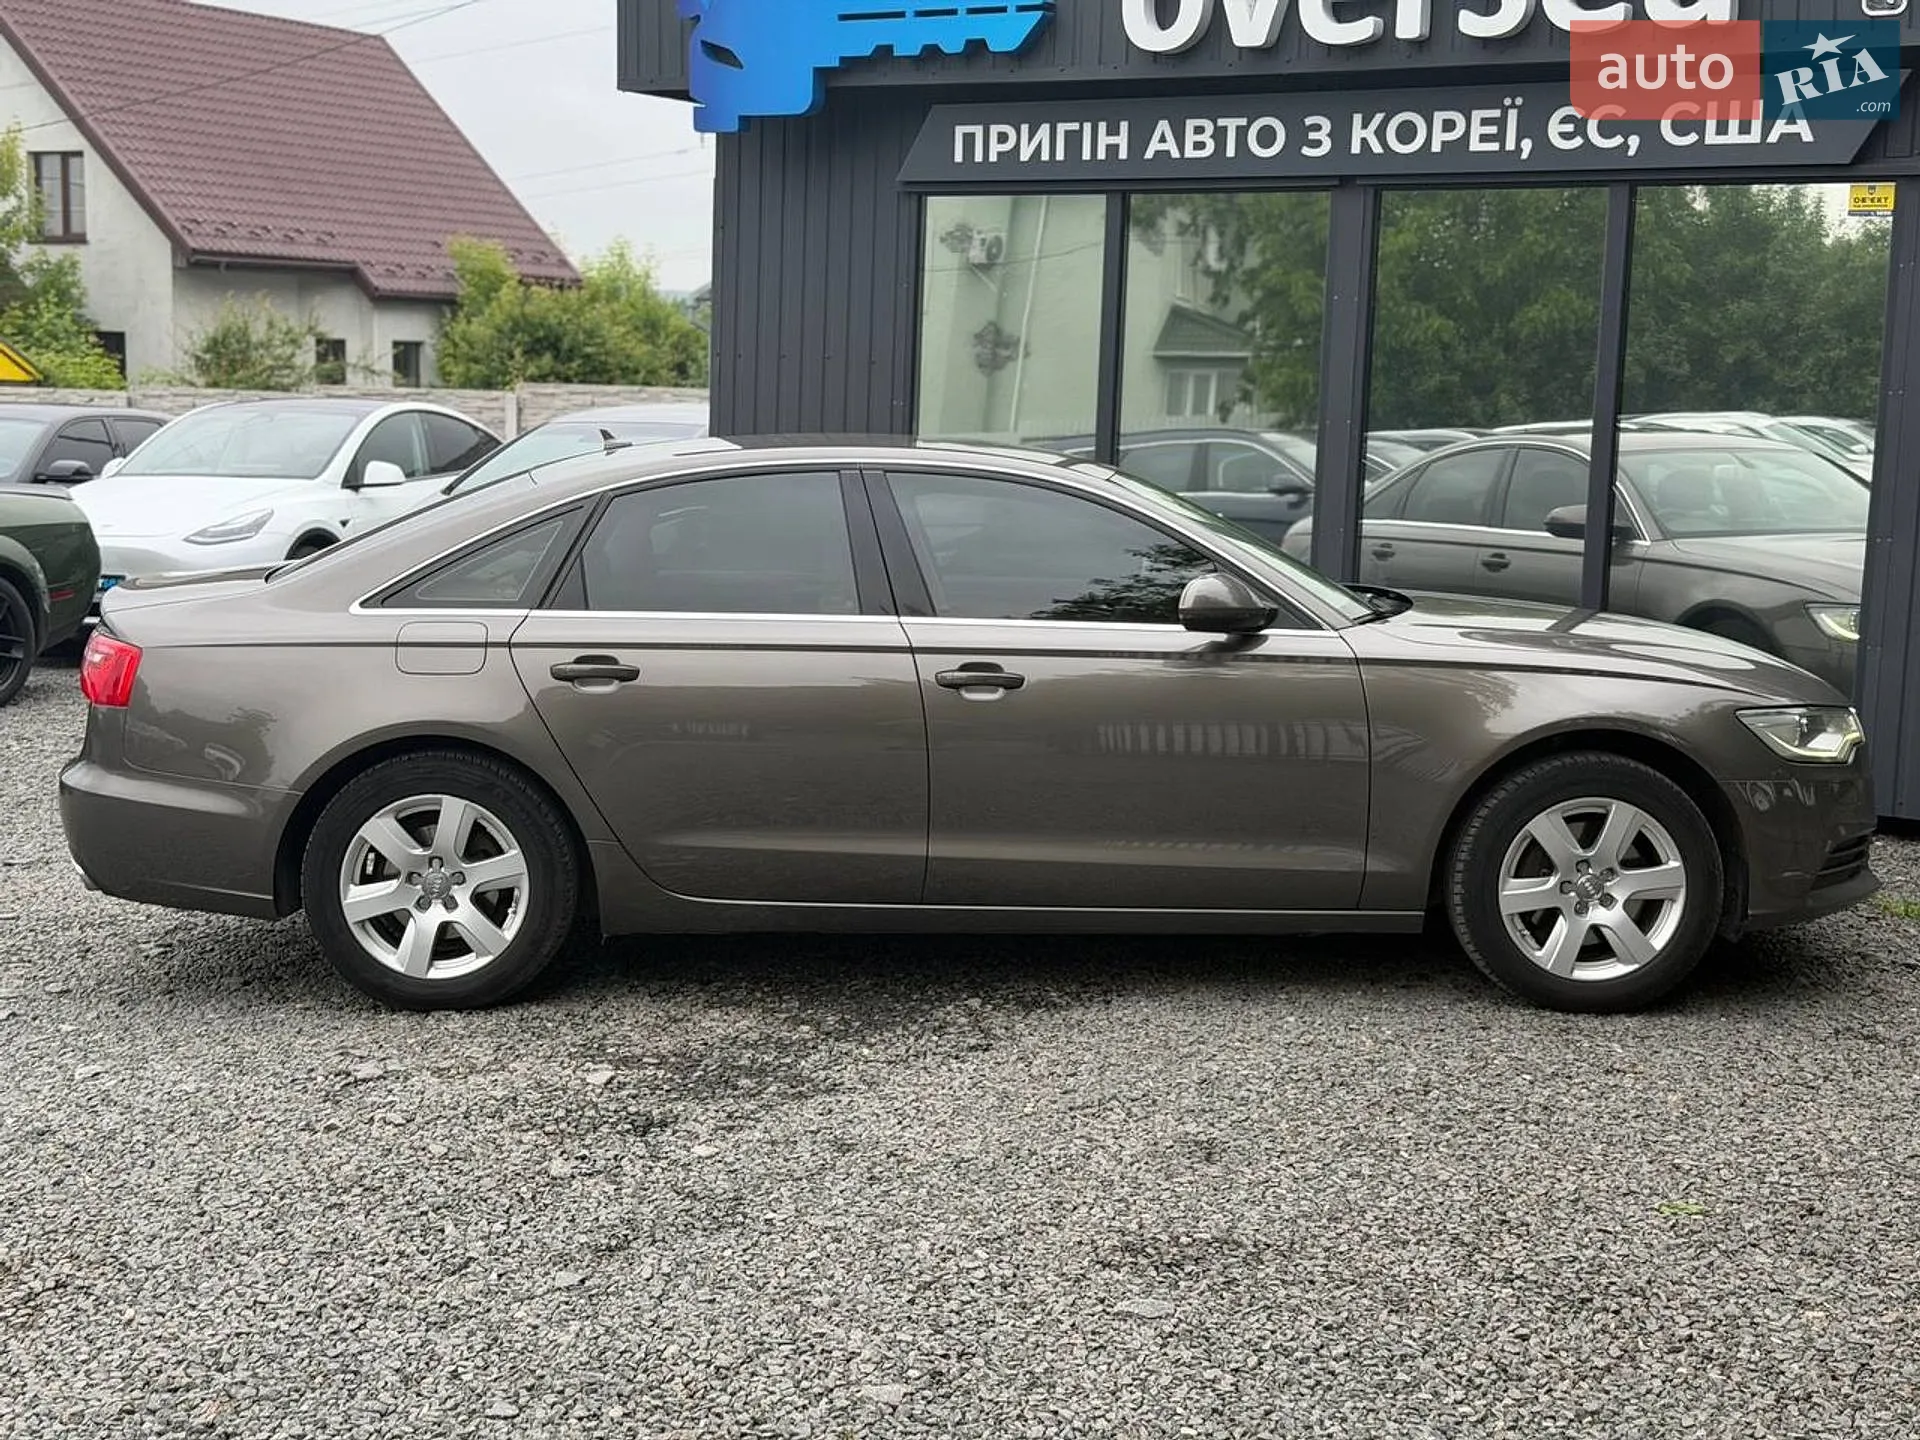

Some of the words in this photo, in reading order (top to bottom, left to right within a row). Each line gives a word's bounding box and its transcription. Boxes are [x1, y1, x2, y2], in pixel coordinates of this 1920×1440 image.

[953, 121, 1129, 163] ПРИГІН
[1143, 116, 1287, 160] АВТО
[1300, 115, 1333, 158] З
[1350, 96, 1533, 159] КОРЕЇ,
[1547, 104, 1641, 157] ЄС,
[1660, 99, 1815, 147] США
